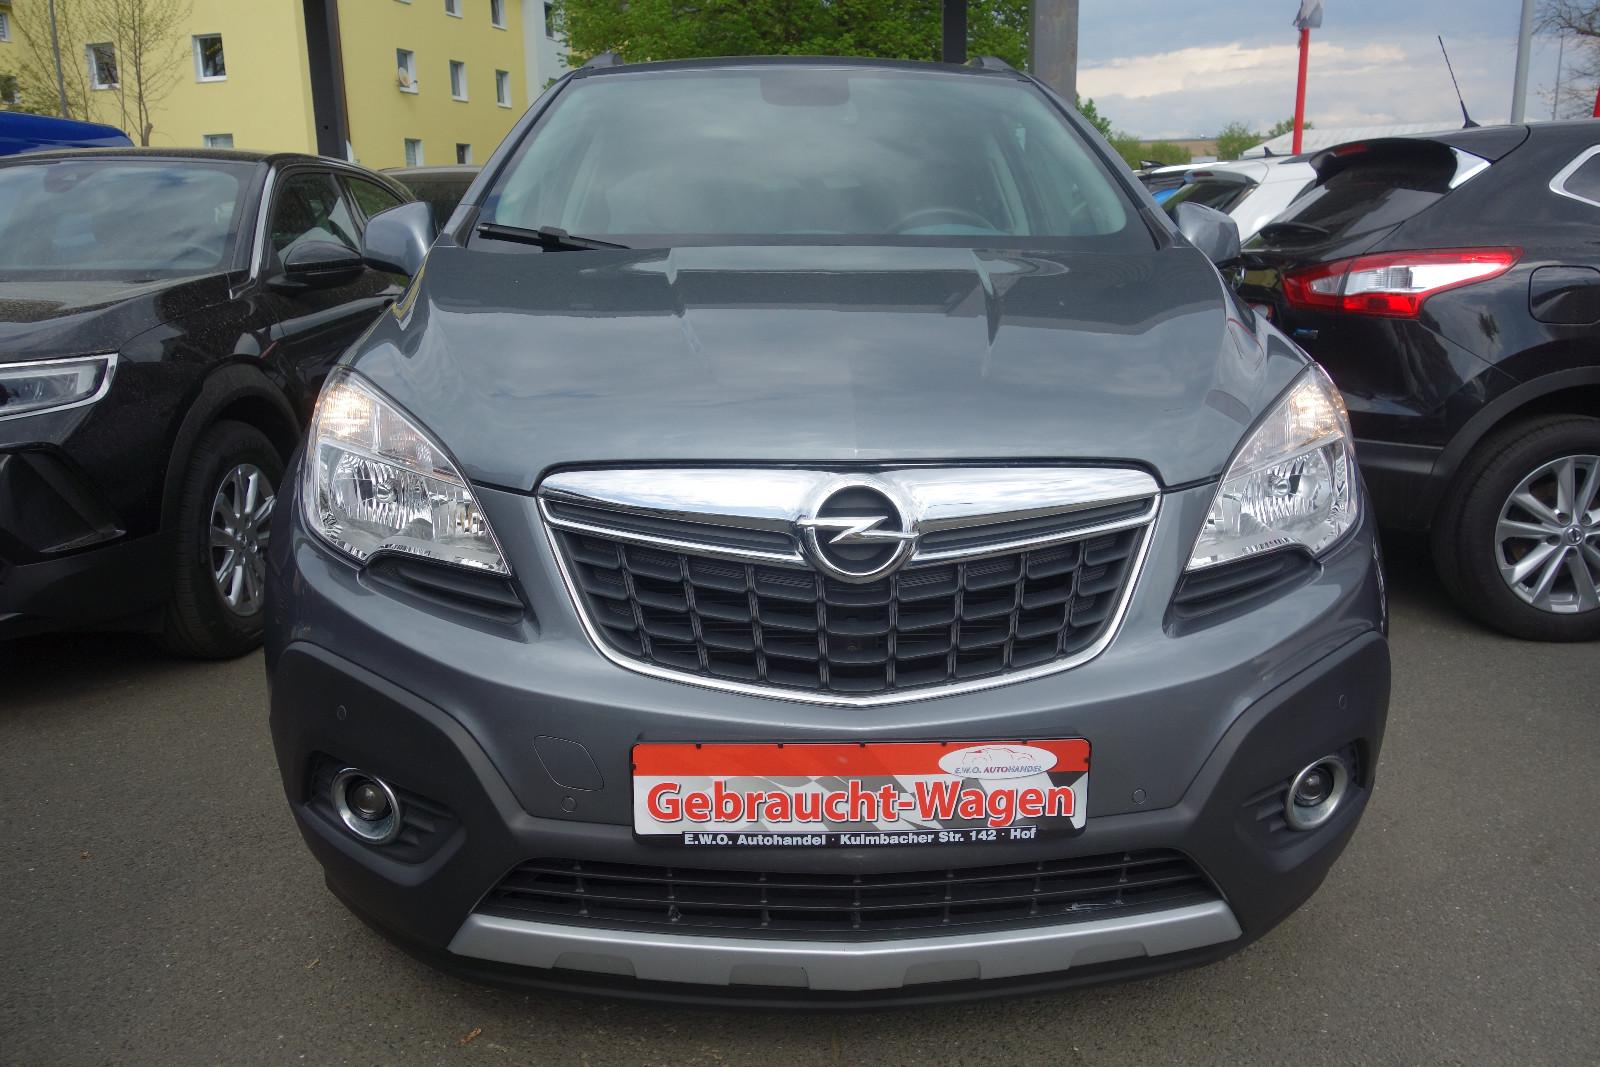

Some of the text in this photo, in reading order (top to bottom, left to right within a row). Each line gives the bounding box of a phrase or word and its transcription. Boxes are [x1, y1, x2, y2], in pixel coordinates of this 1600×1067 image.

[647, 779, 1076, 828] Gebraucht-Wagen
[684, 828, 1037, 846] E.W.O. Autohandel Kulmbacher Str. 142 Hof
